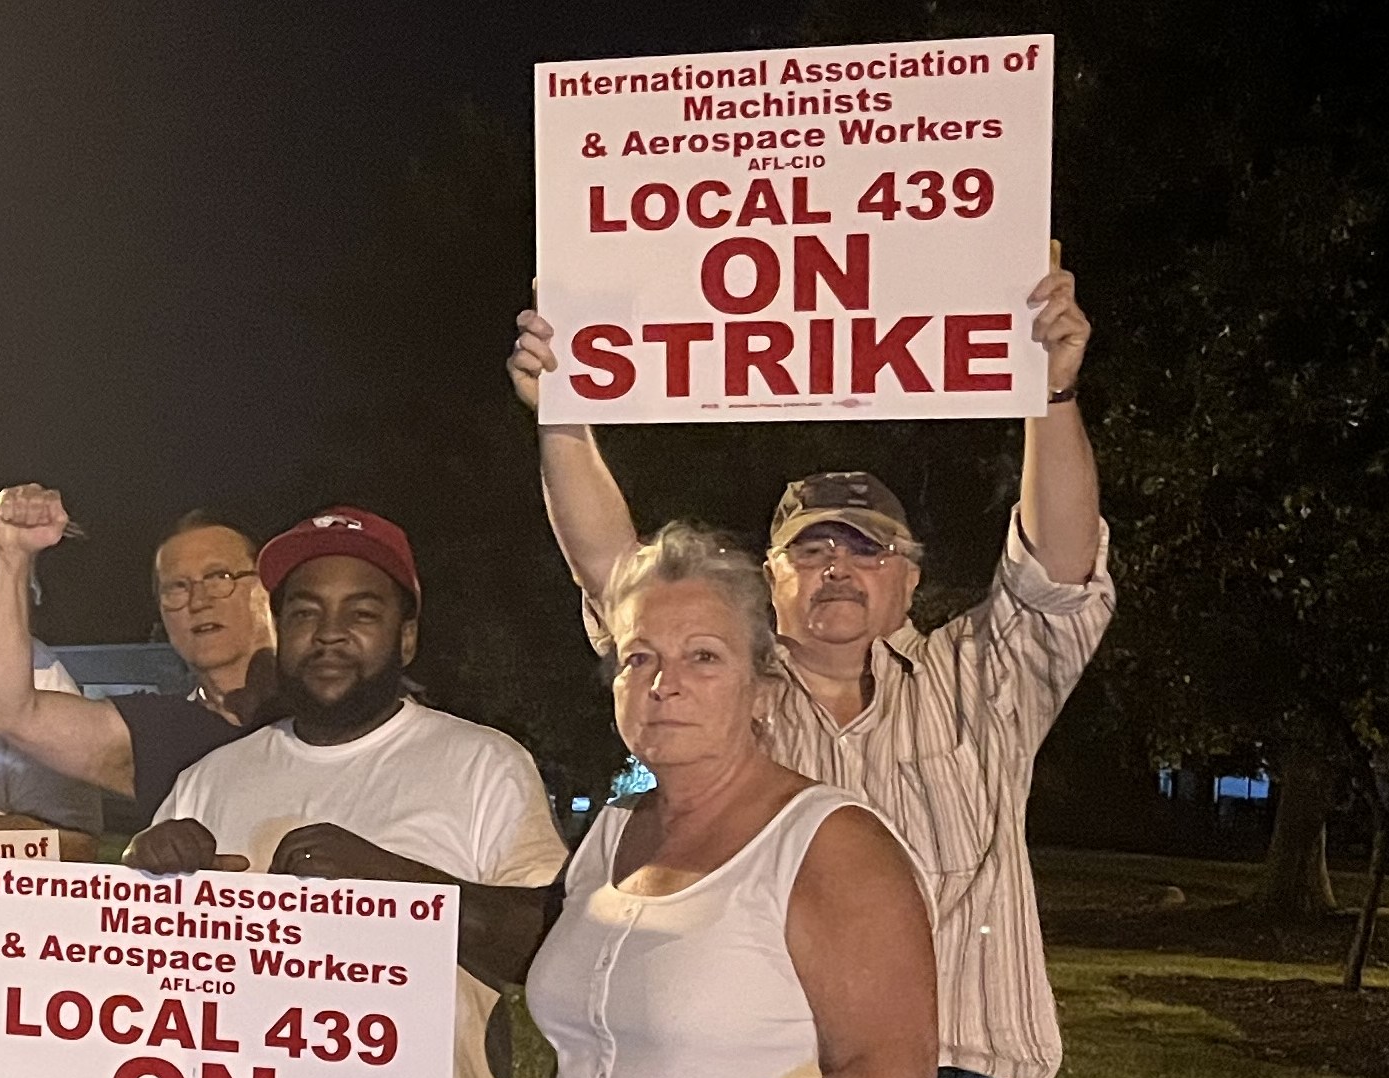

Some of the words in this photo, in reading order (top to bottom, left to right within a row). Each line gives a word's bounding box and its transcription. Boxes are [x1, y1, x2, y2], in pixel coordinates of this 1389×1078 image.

[548, 59, 768, 99] International
[779, 49, 990, 86] Association
[1002, 43, 1041, 73] of
[683, 87, 893, 122] Machinists
[581, 132, 609, 159] &
[620, 127, 826, 159] Aerospace
[838, 115, 1004, 146] Workers
[747, 154, 826, 172] AFL-CIO
[589, 175, 832, 234] LOCAL
[856, 167, 995, 222] 439
[700, 232, 871, 316] ON
[568, 312, 1014, 401] STRIKE
[24, 837, 48, 858] of
[193, 879, 397, 919] Association
[409, 893, 447, 922] of
[100, 906, 302, 946] Machinists
[0, 931, 27, 959] &
[38, 934, 237, 975] Aerospace
[248, 947, 409, 987] Workers
[159, 976, 236, 996] AFL-CIO
[5, 986, 240, 1054] LOCAL
[264, 1006, 399, 1067] 439
